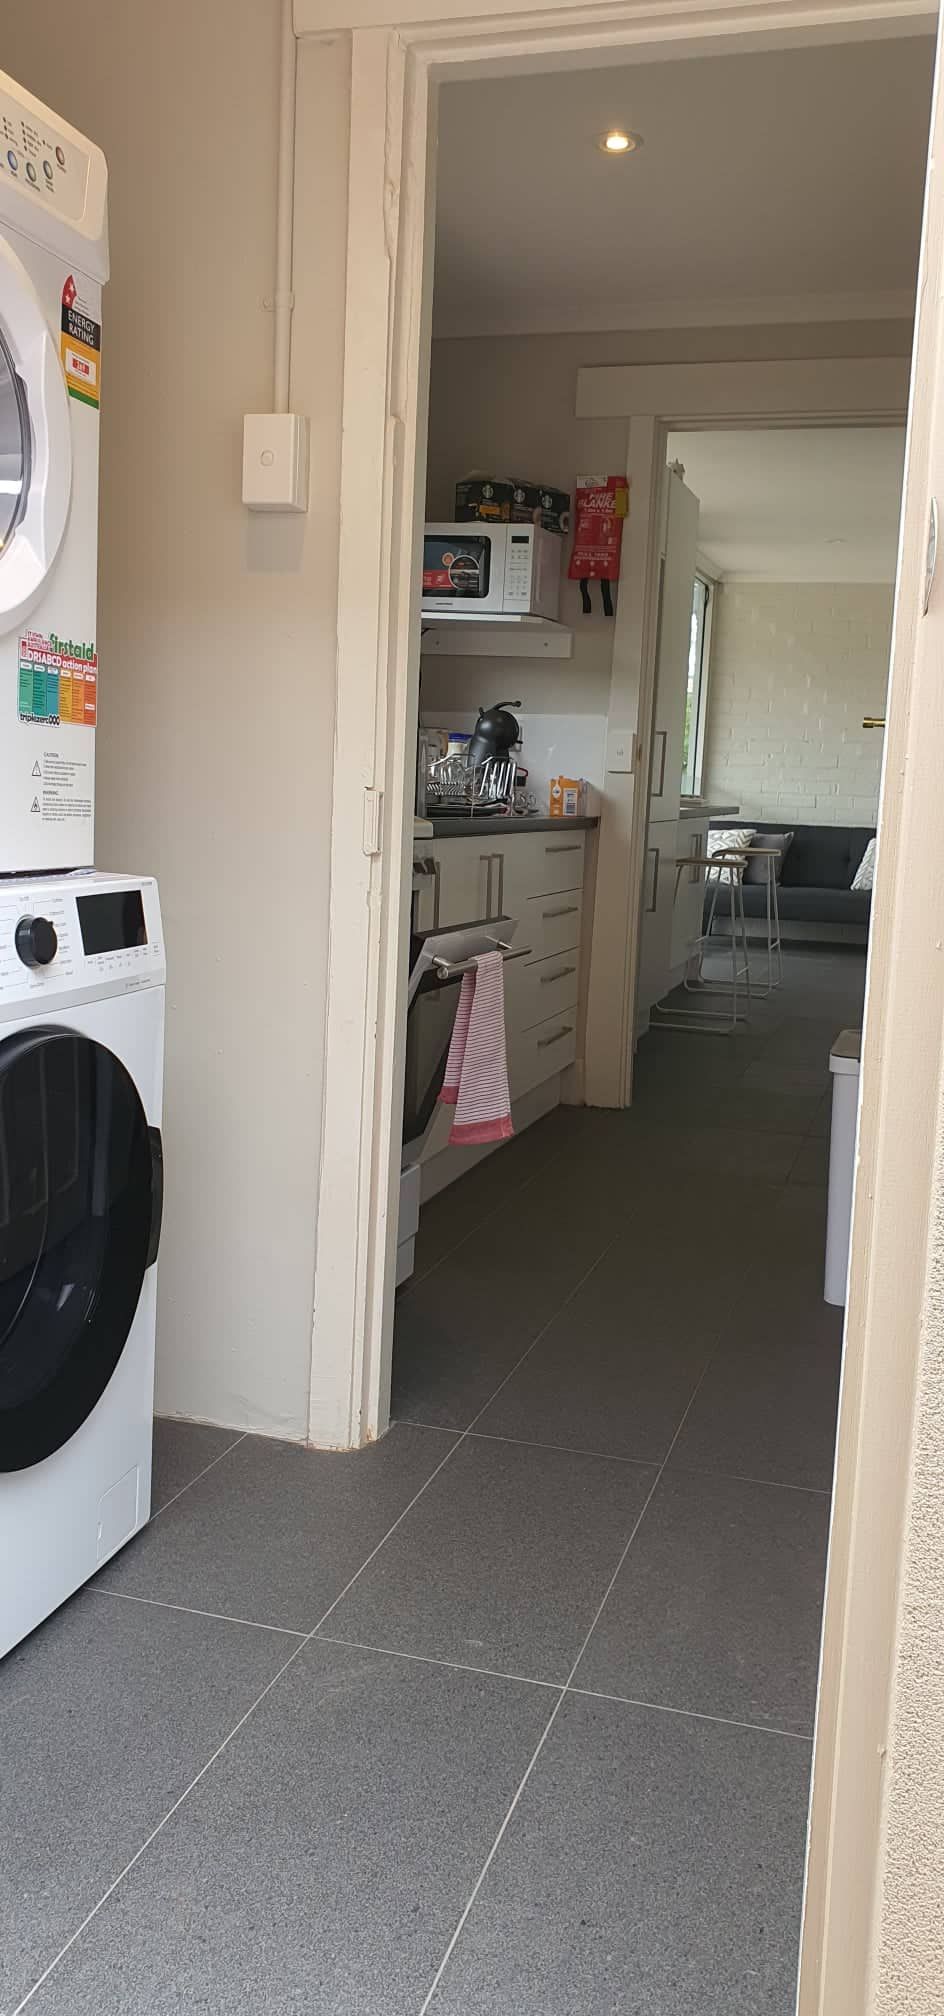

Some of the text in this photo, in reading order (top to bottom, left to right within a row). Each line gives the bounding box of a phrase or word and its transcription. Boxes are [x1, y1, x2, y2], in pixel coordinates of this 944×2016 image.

[68, 310, 95, 334] ENERGY
[68, 322, 94, 345] RATING
[27, 651, 97, 675] DRSABCD action plan
